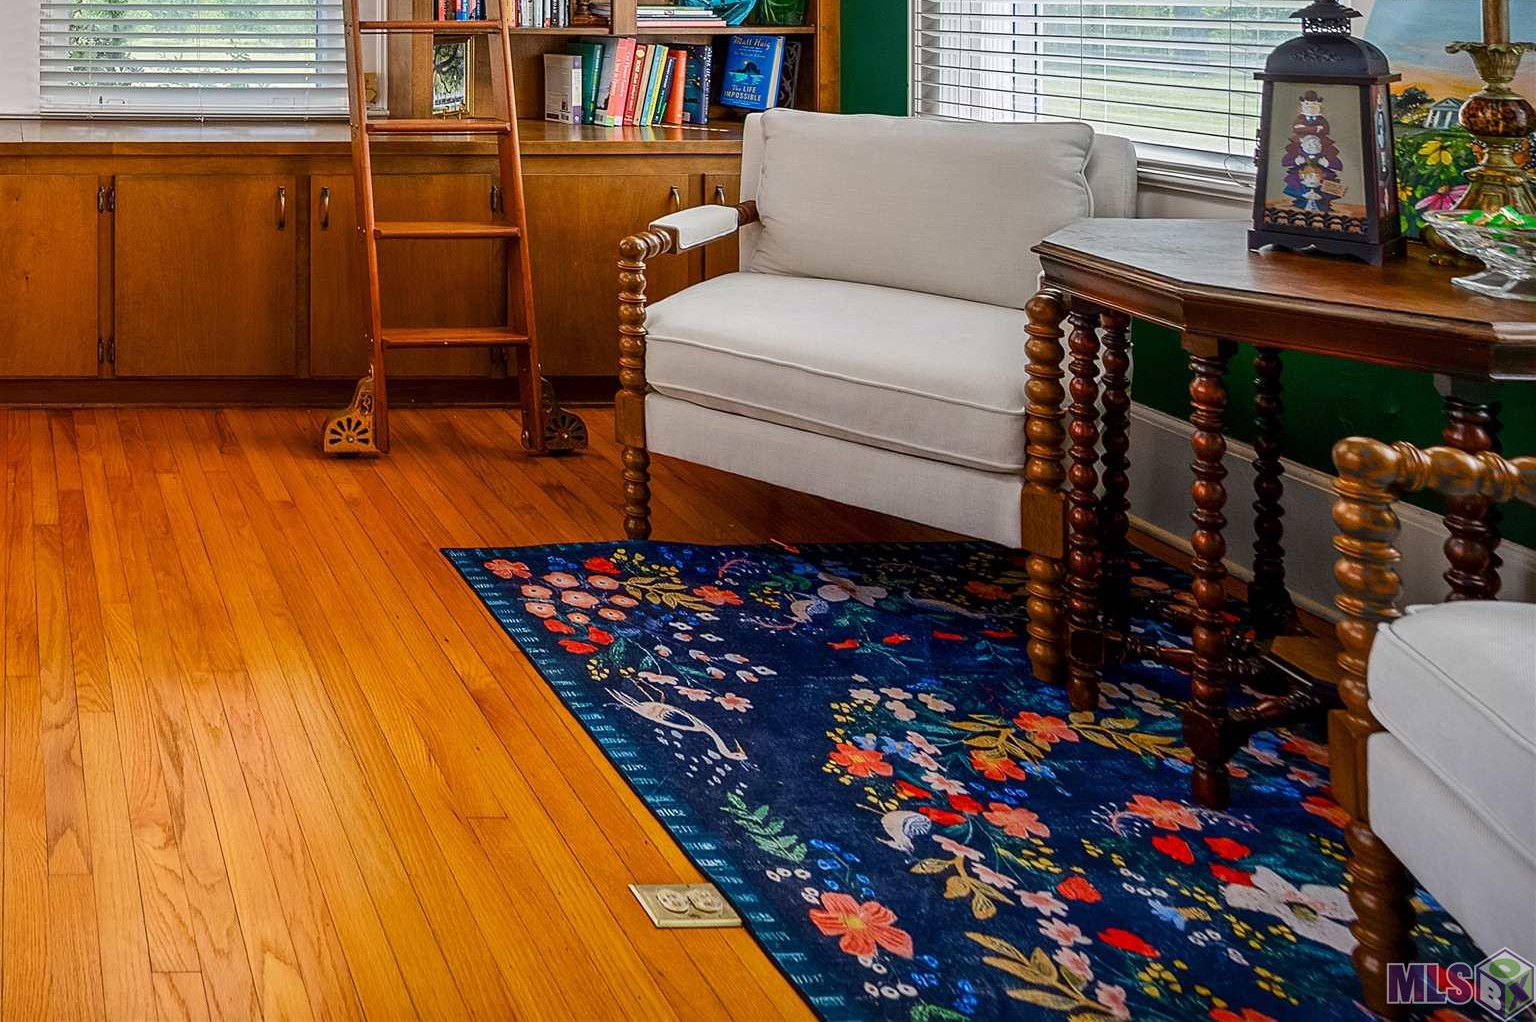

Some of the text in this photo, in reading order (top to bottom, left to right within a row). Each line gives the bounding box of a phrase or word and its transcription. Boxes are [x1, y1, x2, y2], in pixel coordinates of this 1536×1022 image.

[735, 36, 771, 51] Matt Haig
[721, 90, 761, 102] IMPOSSIBLE
